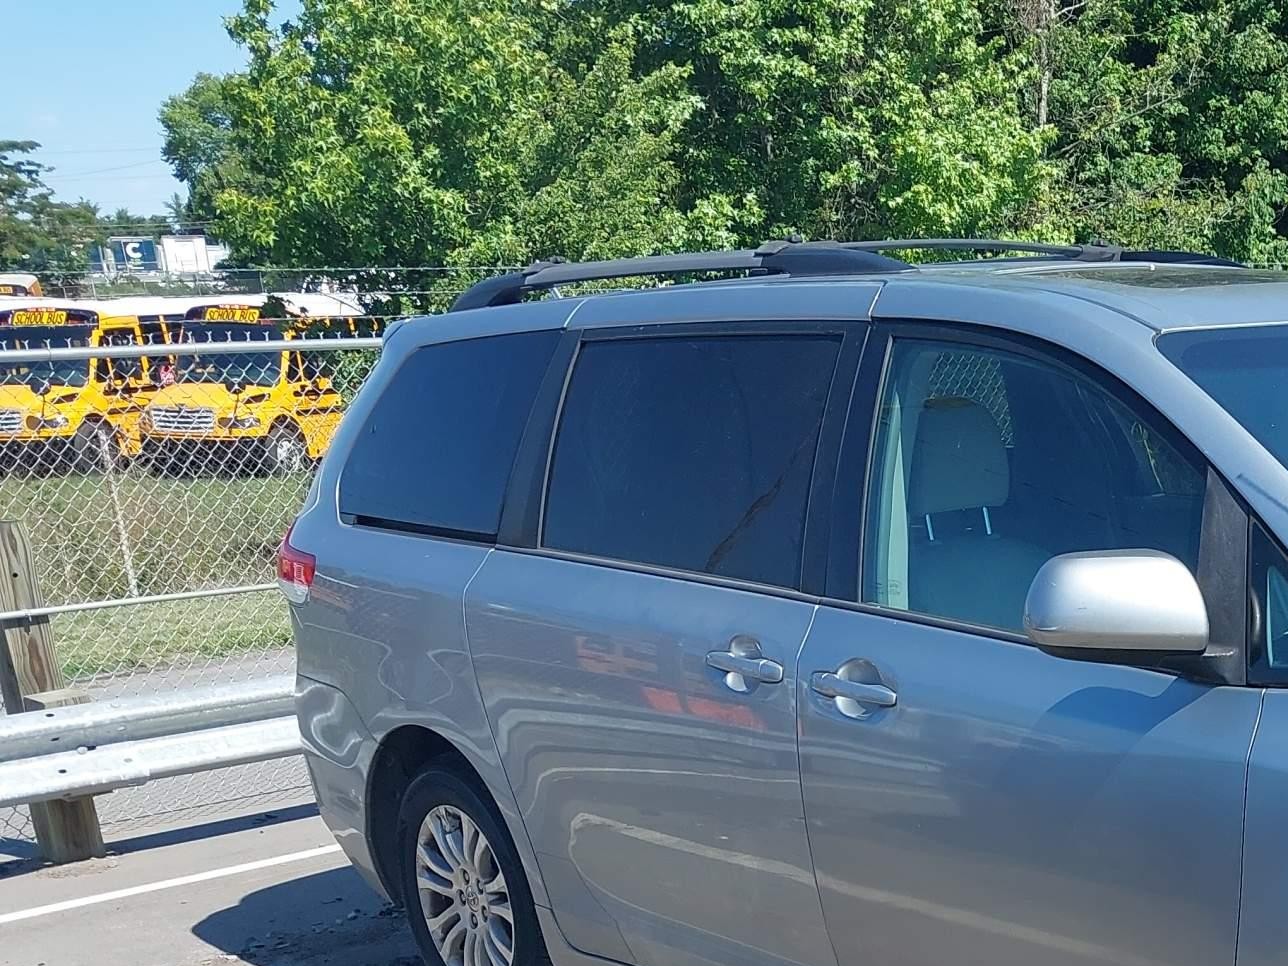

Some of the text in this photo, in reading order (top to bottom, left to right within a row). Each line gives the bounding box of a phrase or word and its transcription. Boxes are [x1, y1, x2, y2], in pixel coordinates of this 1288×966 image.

[14, 312, 64, 325] SCHOOL BUS
[207, 309, 257, 323] SCHOOL BUS
